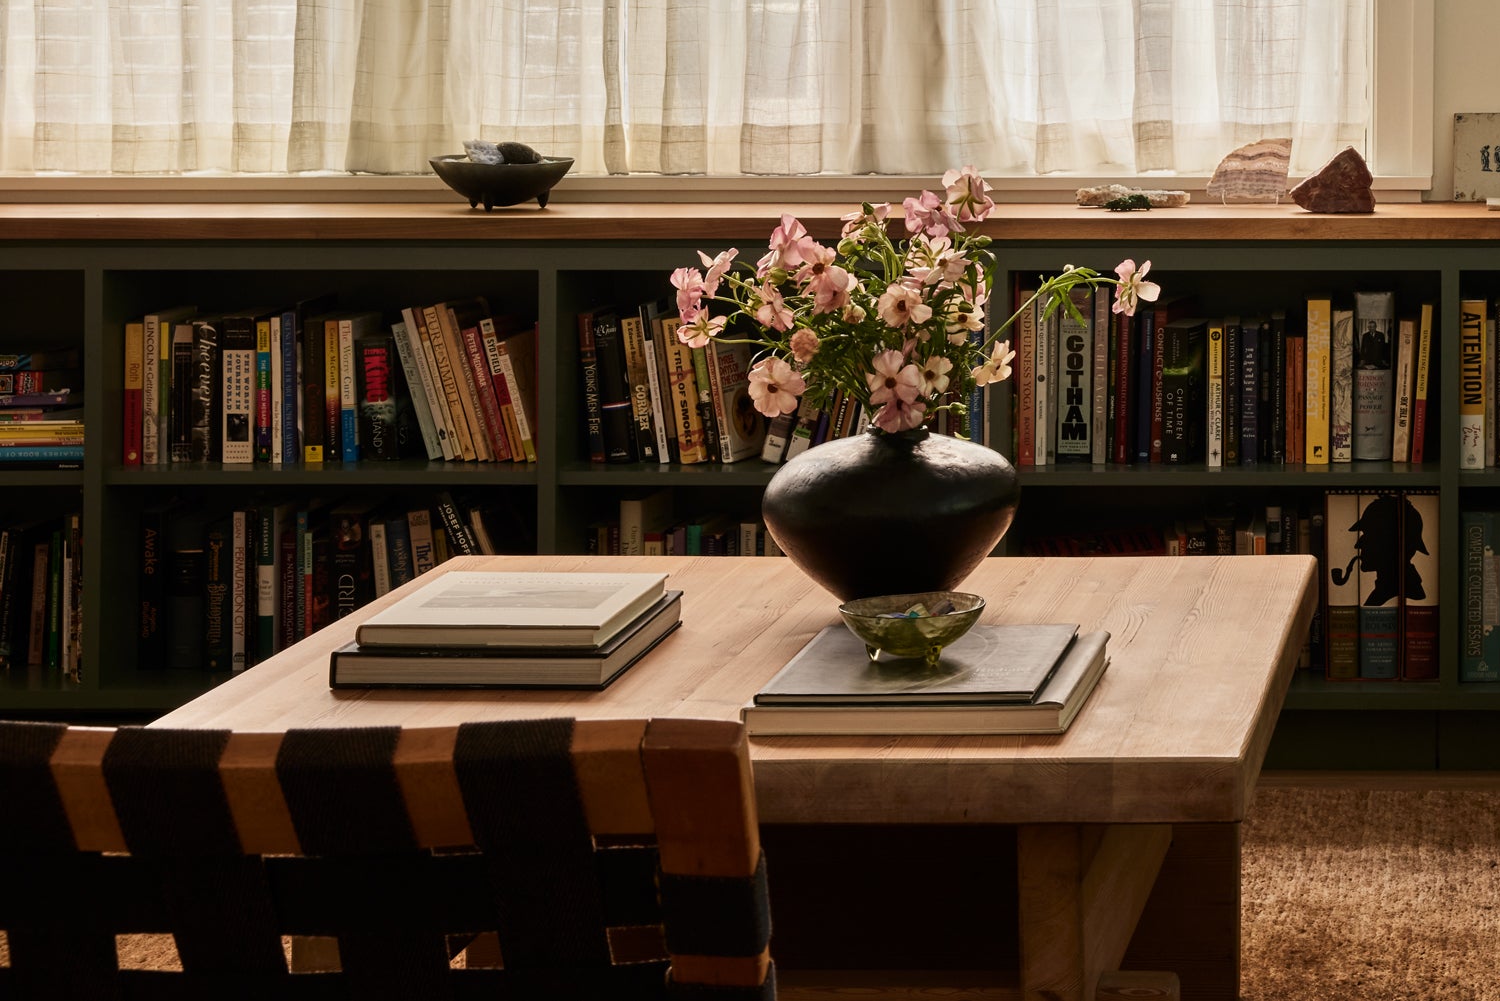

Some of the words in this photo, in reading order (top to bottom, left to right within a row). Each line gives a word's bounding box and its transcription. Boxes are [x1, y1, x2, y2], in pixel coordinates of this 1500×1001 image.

[146, 321, 154, 366] LINCOLN
[342, 323, 350, 342] The
[486, 338, 496, 354] SYD
[628, 327, 637, 351] Edward
[1155, 327, 1165, 369] CONFLICT
[1306, 310, 1319, 353] DARK
[1319, 319, 1330, 349] THE
[199, 323, 218, 406] Cheever
[342, 341, 351, 374] Worry
[425, 311, 444, 352] PURE
[438, 356, 460, 409] SIMPLE
[465, 332, 477, 355] PETER
[471, 352, 487, 388] MEDAWAR
[489, 353, 502, 374] FIELD
[673, 349, 684, 382] TREE
[1421, 329, 1430, 371] UNLIMITING
[1462, 311, 1482, 405] ATTENTION
[129, 363, 140, 383] Roth
[343, 376, 352, 400] Cure
[364, 356, 389, 402] KING
[583, 363, 597, 392] YOUNG
[678, 382, 687, 397] OF
[1062, 335, 1088, 441] GOTHAM
[1096, 343, 1105, 414] CHICAGO
[1154, 370, 1163, 380] &
[1306, 359, 1319, 419] FOREST
[145, 372, 154, 416] Gettysburg
[236, 400, 241, 410] IN
[586, 393, 599, 413] MEN
[633, 384, 650, 431] CORNER
[972, 386, 981, 413] orkbook
[1023, 382, 1032, 412] YOGA
[1154, 380, 1163, 423] SUSPENSE
[1166, 392, 1174, 409] OF
[1400, 396, 1409, 408] JOB
[588, 417, 601, 435] FIRE
[680, 399, 693, 446] SMOKE
[1166, 410, 1174, 435] TIME
[1175, 387, 1184, 441] CHILDREN
[1398, 420, 1407, 428] ON
[1399, 408, 1408, 419] THE
[371, 414, 383, 448] STAND
[234, 517, 242, 539] EGAN
[262, 517, 270, 558] ADYASHANTI
[442, 503, 460, 531] JOSEF
[454, 531, 472, 555] HOFF
[144, 527, 158, 576] Awake
[416, 542, 432, 562] The
[1468, 526, 1483, 572] COMPLETE
[234, 546, 245, 613] PERMUTATION
[286, 562, 295, 601] NATURAL
[297, 565, 305, 632] COMMUNICATION
[1468, 574, 1483, 622] COLLECTED
[234, 615, 245, 637] CITY
[286, 601, 295, 646] NAVIGATO
[1467, 623, 1483, 656] ESSAYS
